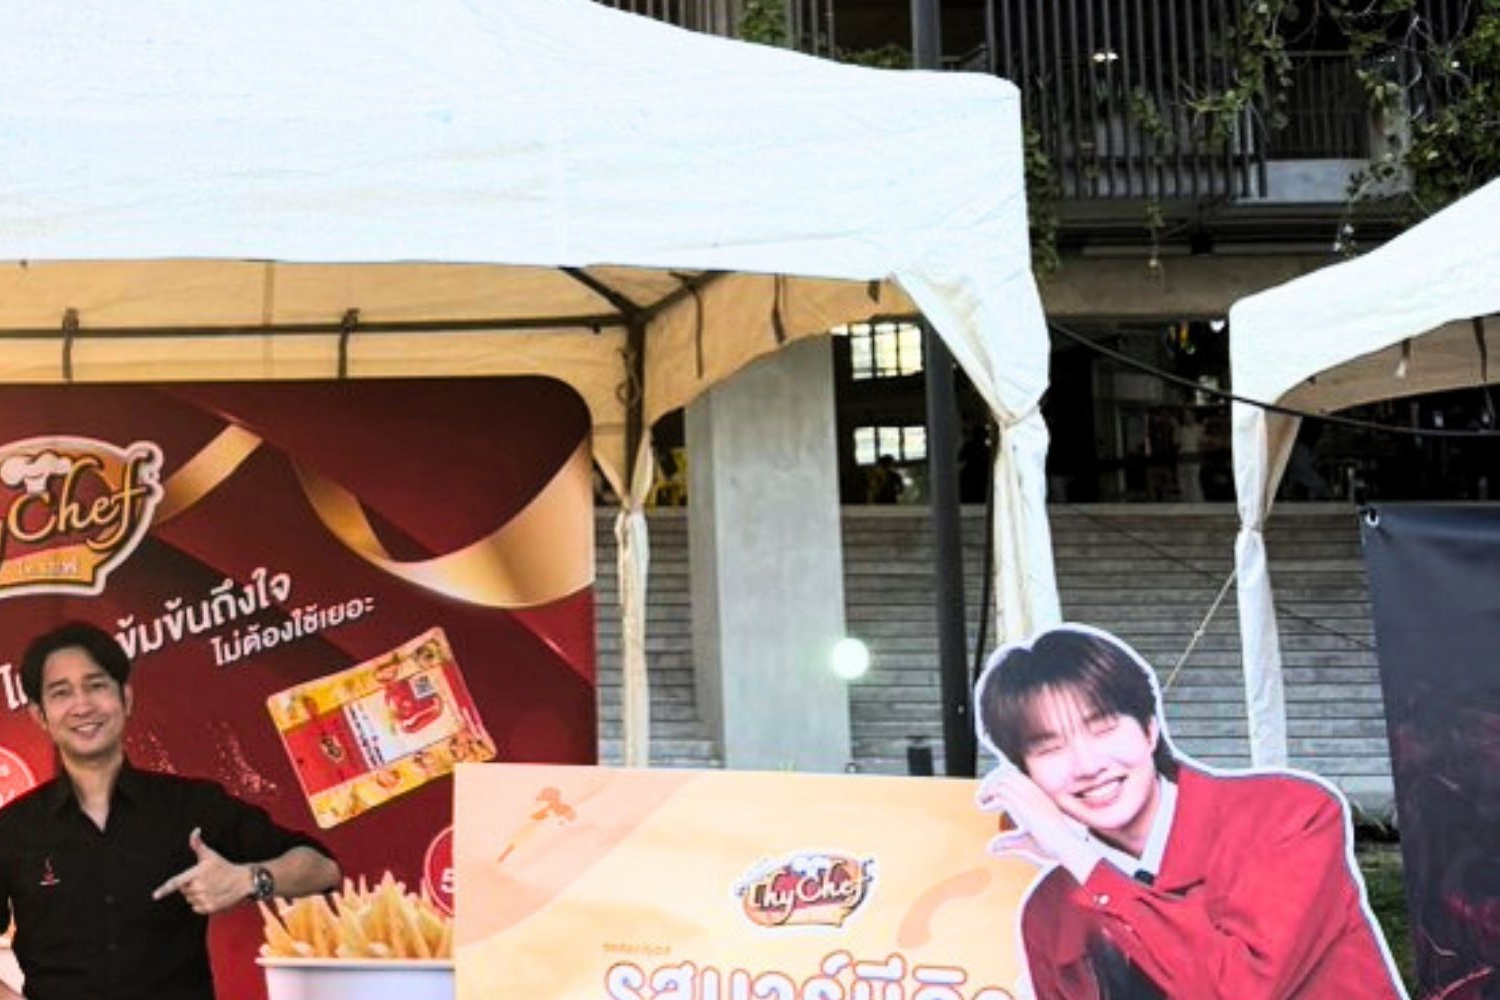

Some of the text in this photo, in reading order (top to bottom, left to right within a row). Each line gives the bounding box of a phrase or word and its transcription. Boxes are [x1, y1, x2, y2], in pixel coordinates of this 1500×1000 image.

[8, 450, 149, 551] Chef
[114, 567, 291, 660] ข้มข้นถึงใจ
[211, 597, 375, 666] ไม่ต้องใช้เยอะ
